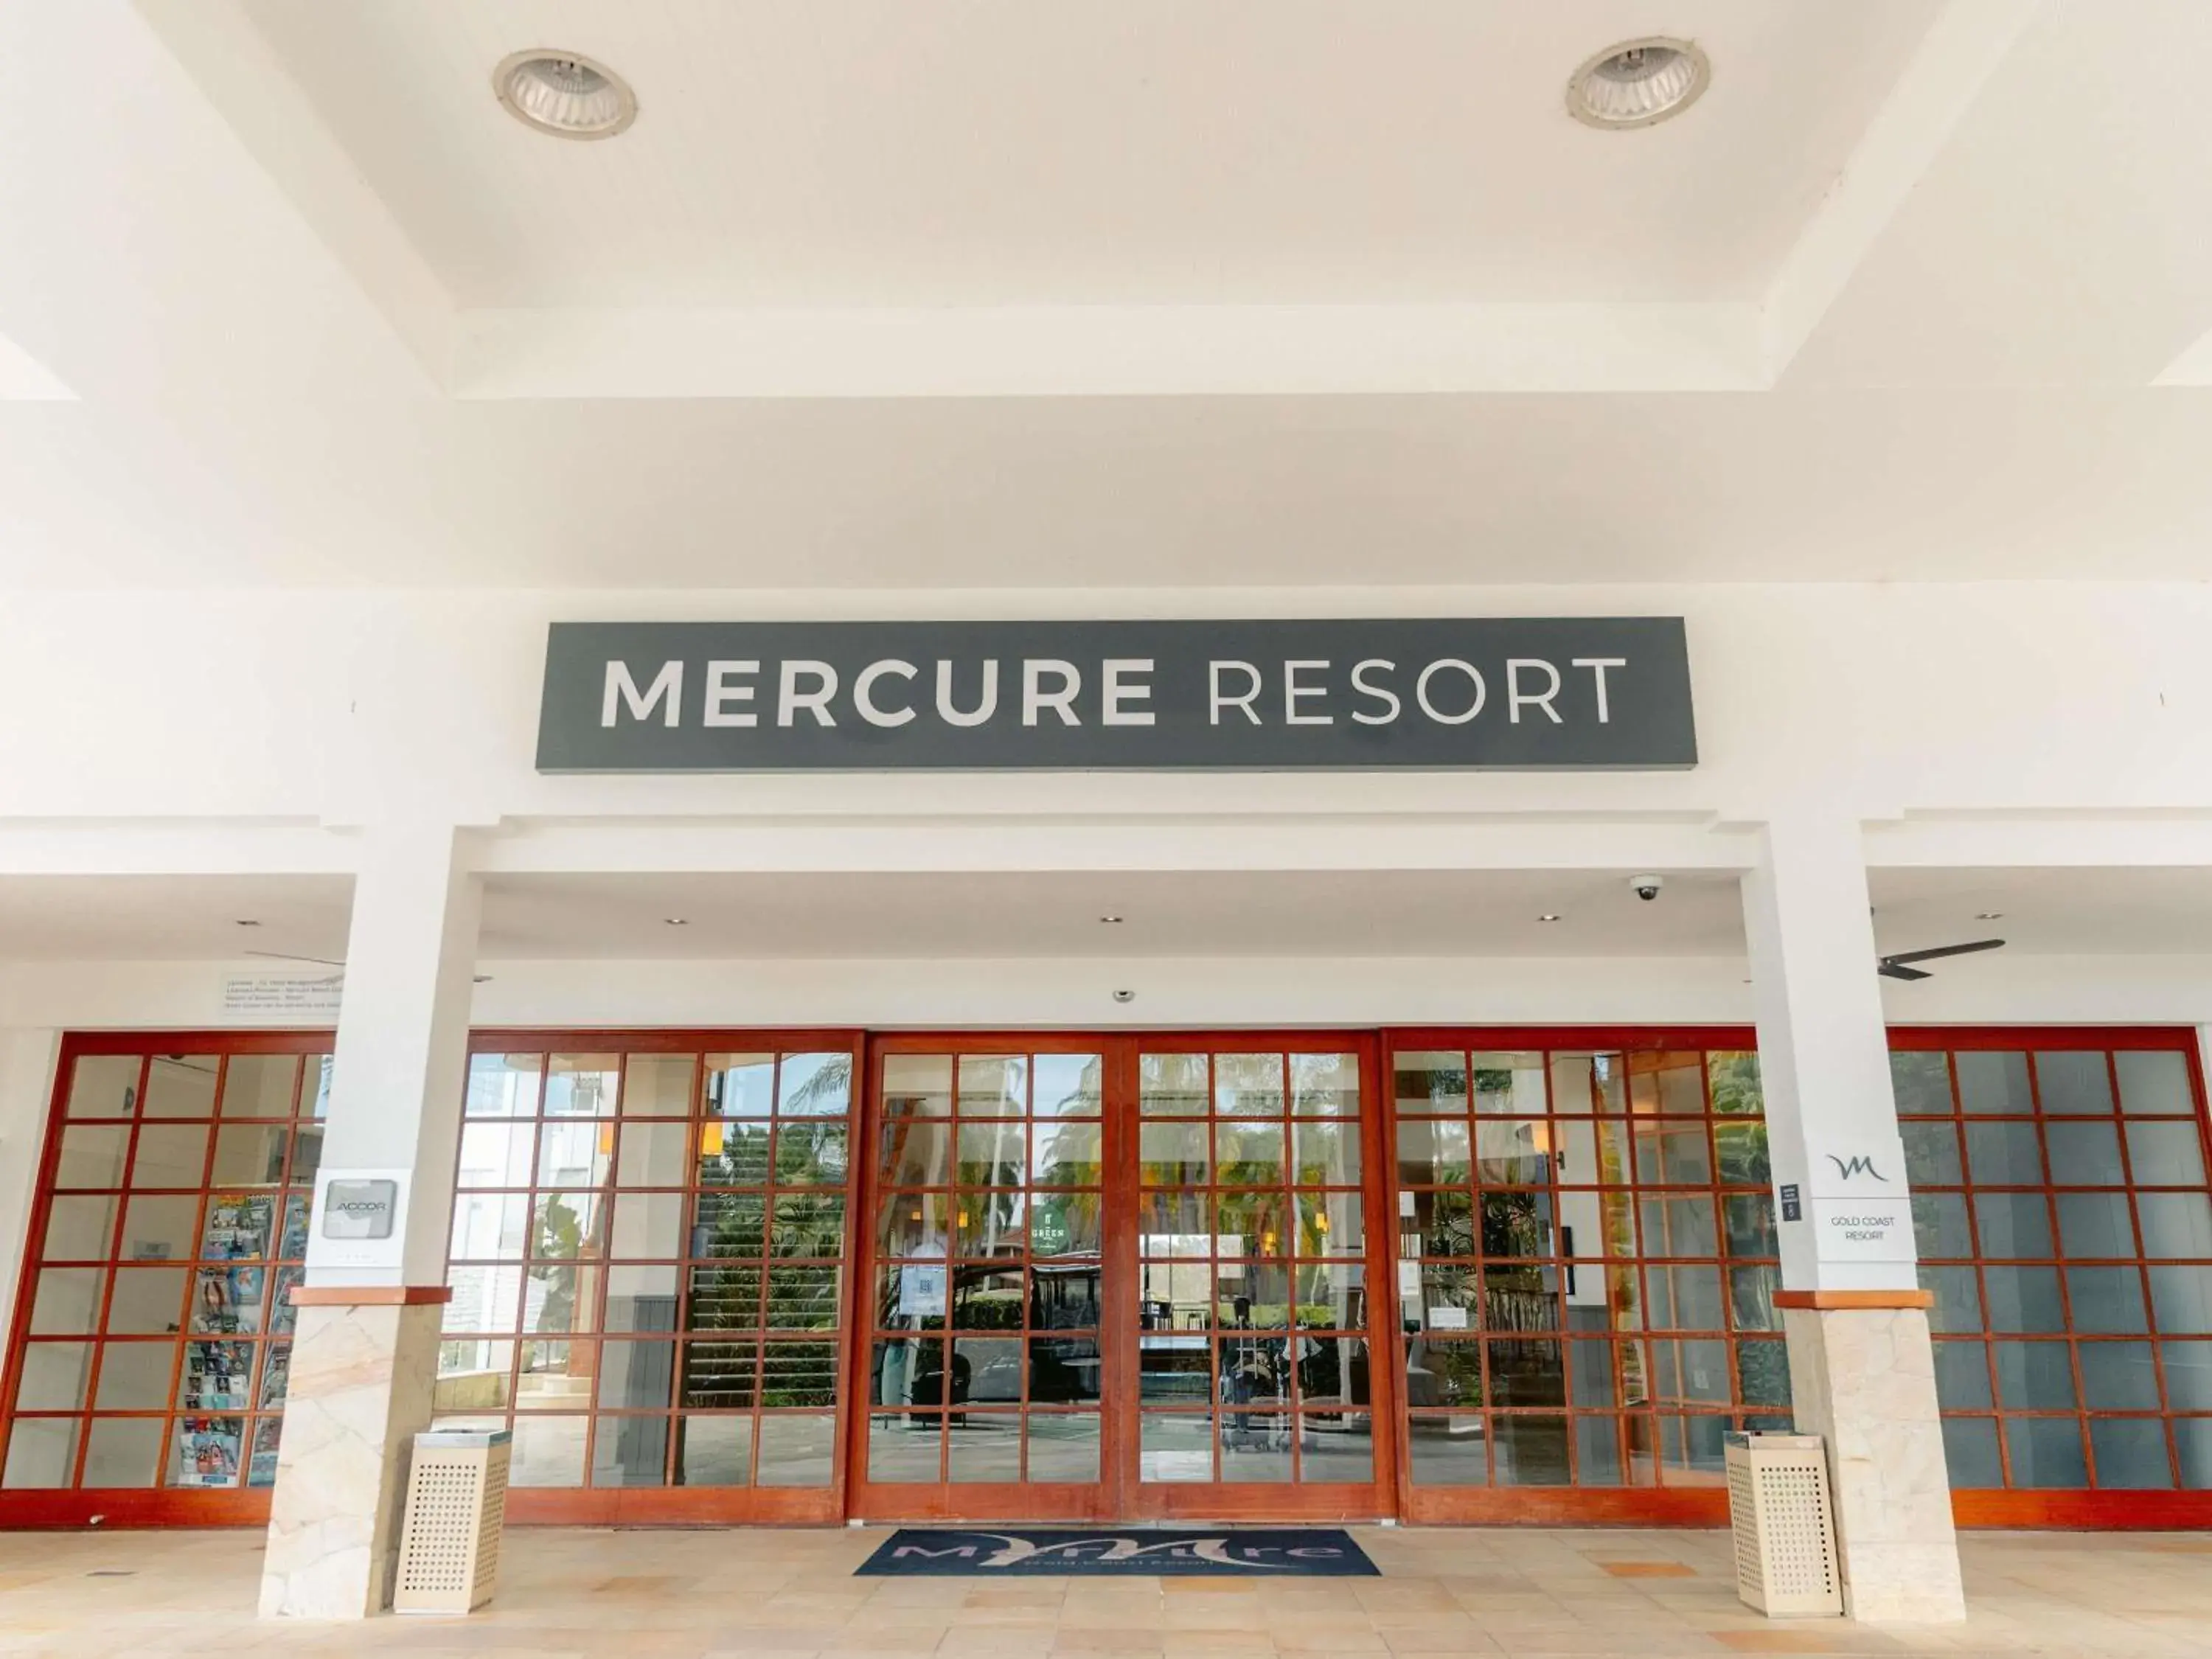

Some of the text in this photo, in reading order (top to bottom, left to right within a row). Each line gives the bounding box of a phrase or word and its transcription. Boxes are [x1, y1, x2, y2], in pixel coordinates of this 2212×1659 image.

[600, 658, 1627, 728] MERCURE RESORT
[1830, 1216, 1895, 1226] GOLD COAST
[1032, 1228, 1064, 1237] GREEN
[1845, 1230, 1885, 1240] RESORT
[891, 1545, 1344, 1558] Mrure
